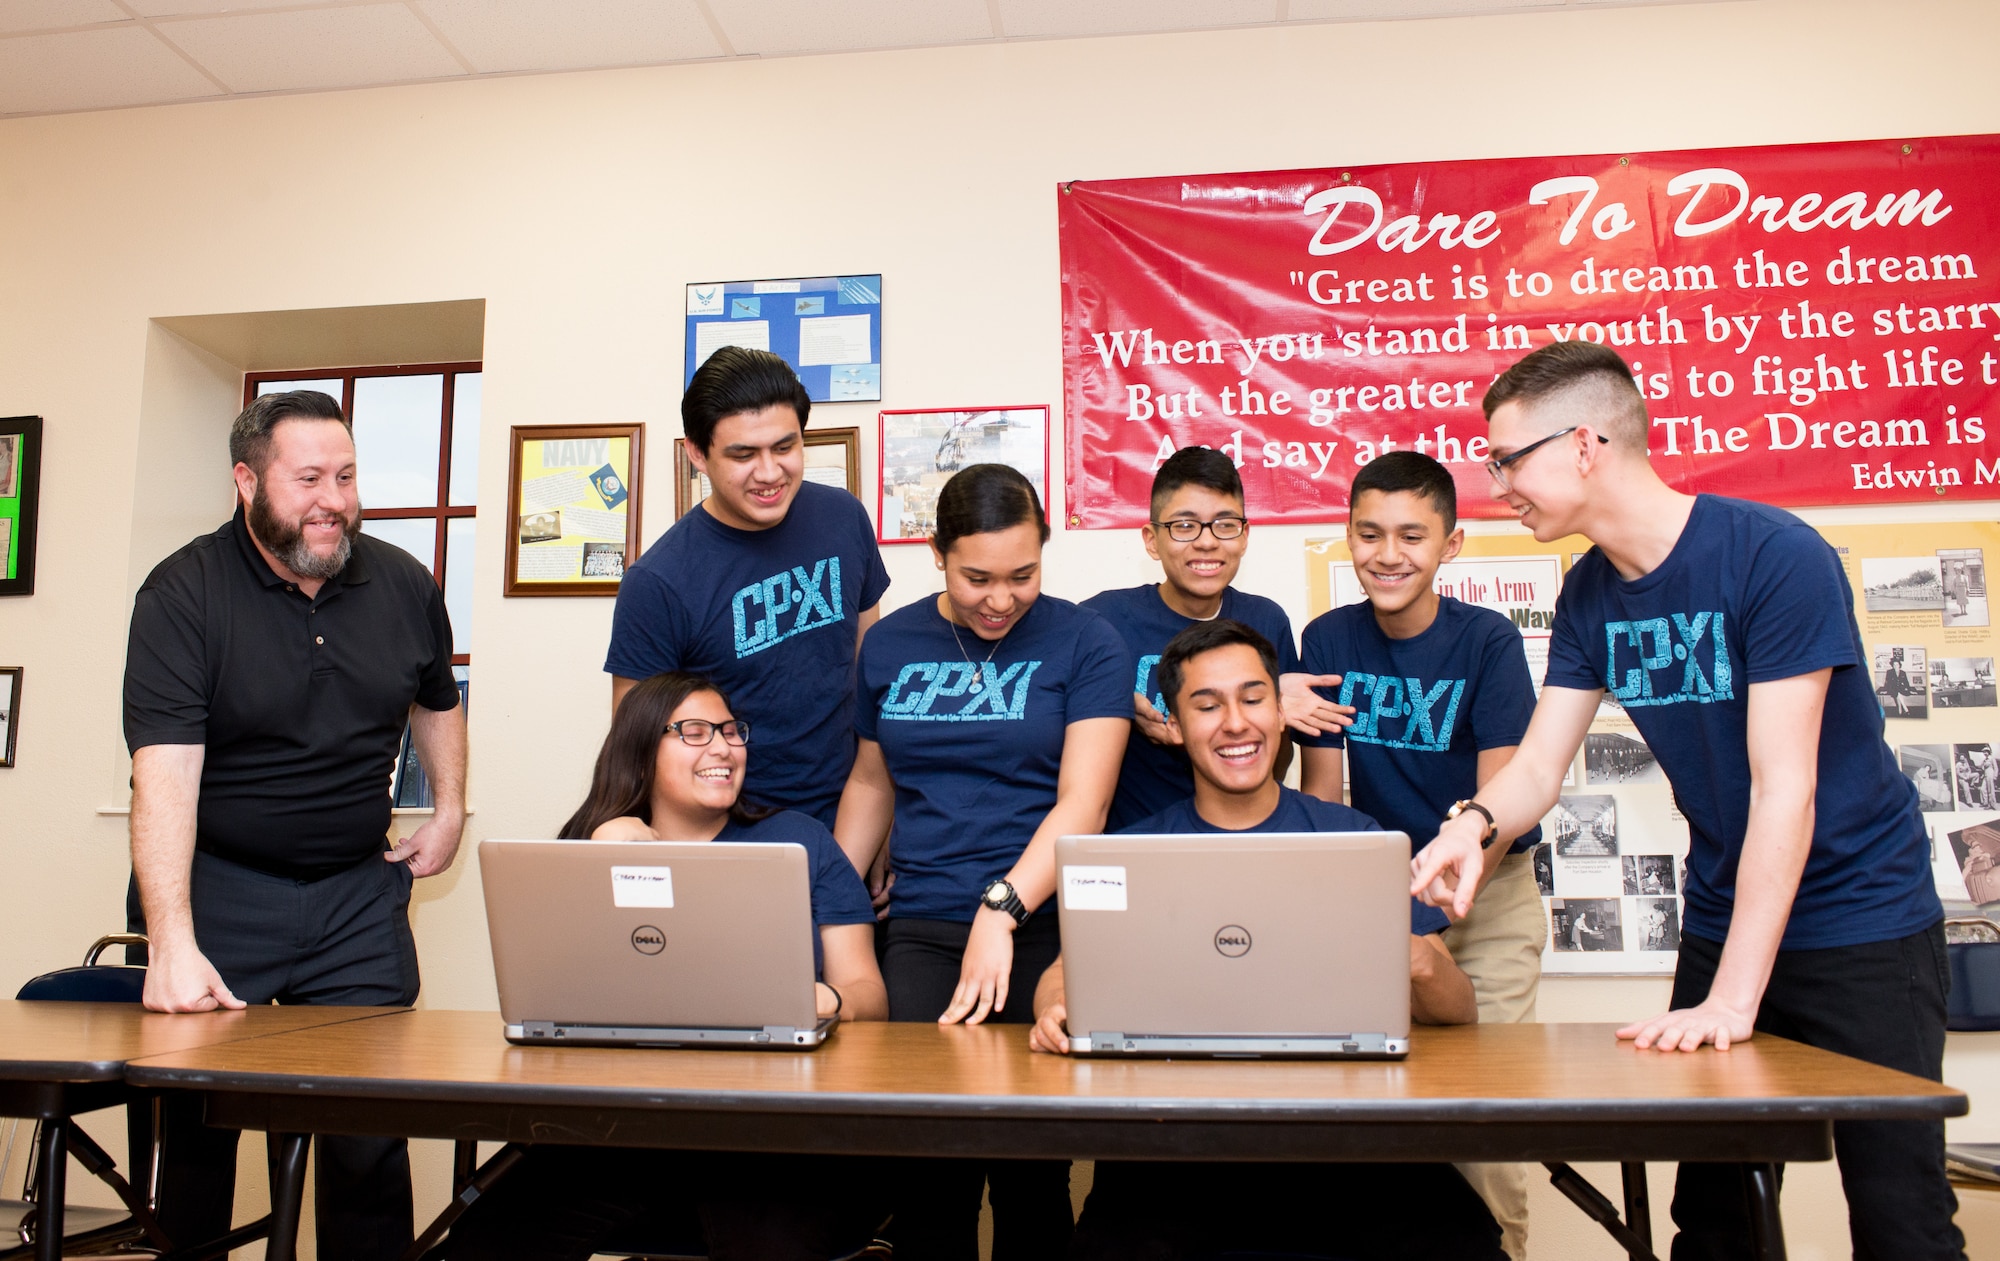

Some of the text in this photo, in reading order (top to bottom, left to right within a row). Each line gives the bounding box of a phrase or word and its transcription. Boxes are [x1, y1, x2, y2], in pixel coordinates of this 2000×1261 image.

[1303, 168, 1953, 256] Dare To Dream
[1289, 246, 1978, 305] "Great is to dream the dream
[1092, 329, 1224, 370] When
[1235, 332, 1324, 375] you
[1343, 314, 1471, 358] stand
[1486, 313, 1533, 350] in
[1702, 304, 1762, 354] by
[1778, 300, 1856, 339] the
[1126, 346, 1998, 427] But the greater is to fight life t
[543, 439, 609, 468] NAVY
[1151, 430, 1246, 471] Ad
[1263, 441, 1338, 480] say
[1354, 434, 1397, 467] at
[1414, 425, 1490, 464] the
[1764, 412, 1930, 450] Dream
[1946, 404, 1987, 445] is
[1851, 457, 2000, 490] Edwin M
[1438, 576, 1537, 607] in the Army
[1509, 608, 1554, 630] Way
[635, 935, 663, 945] DELL
[1218, 936, 1248, 946] DELL
